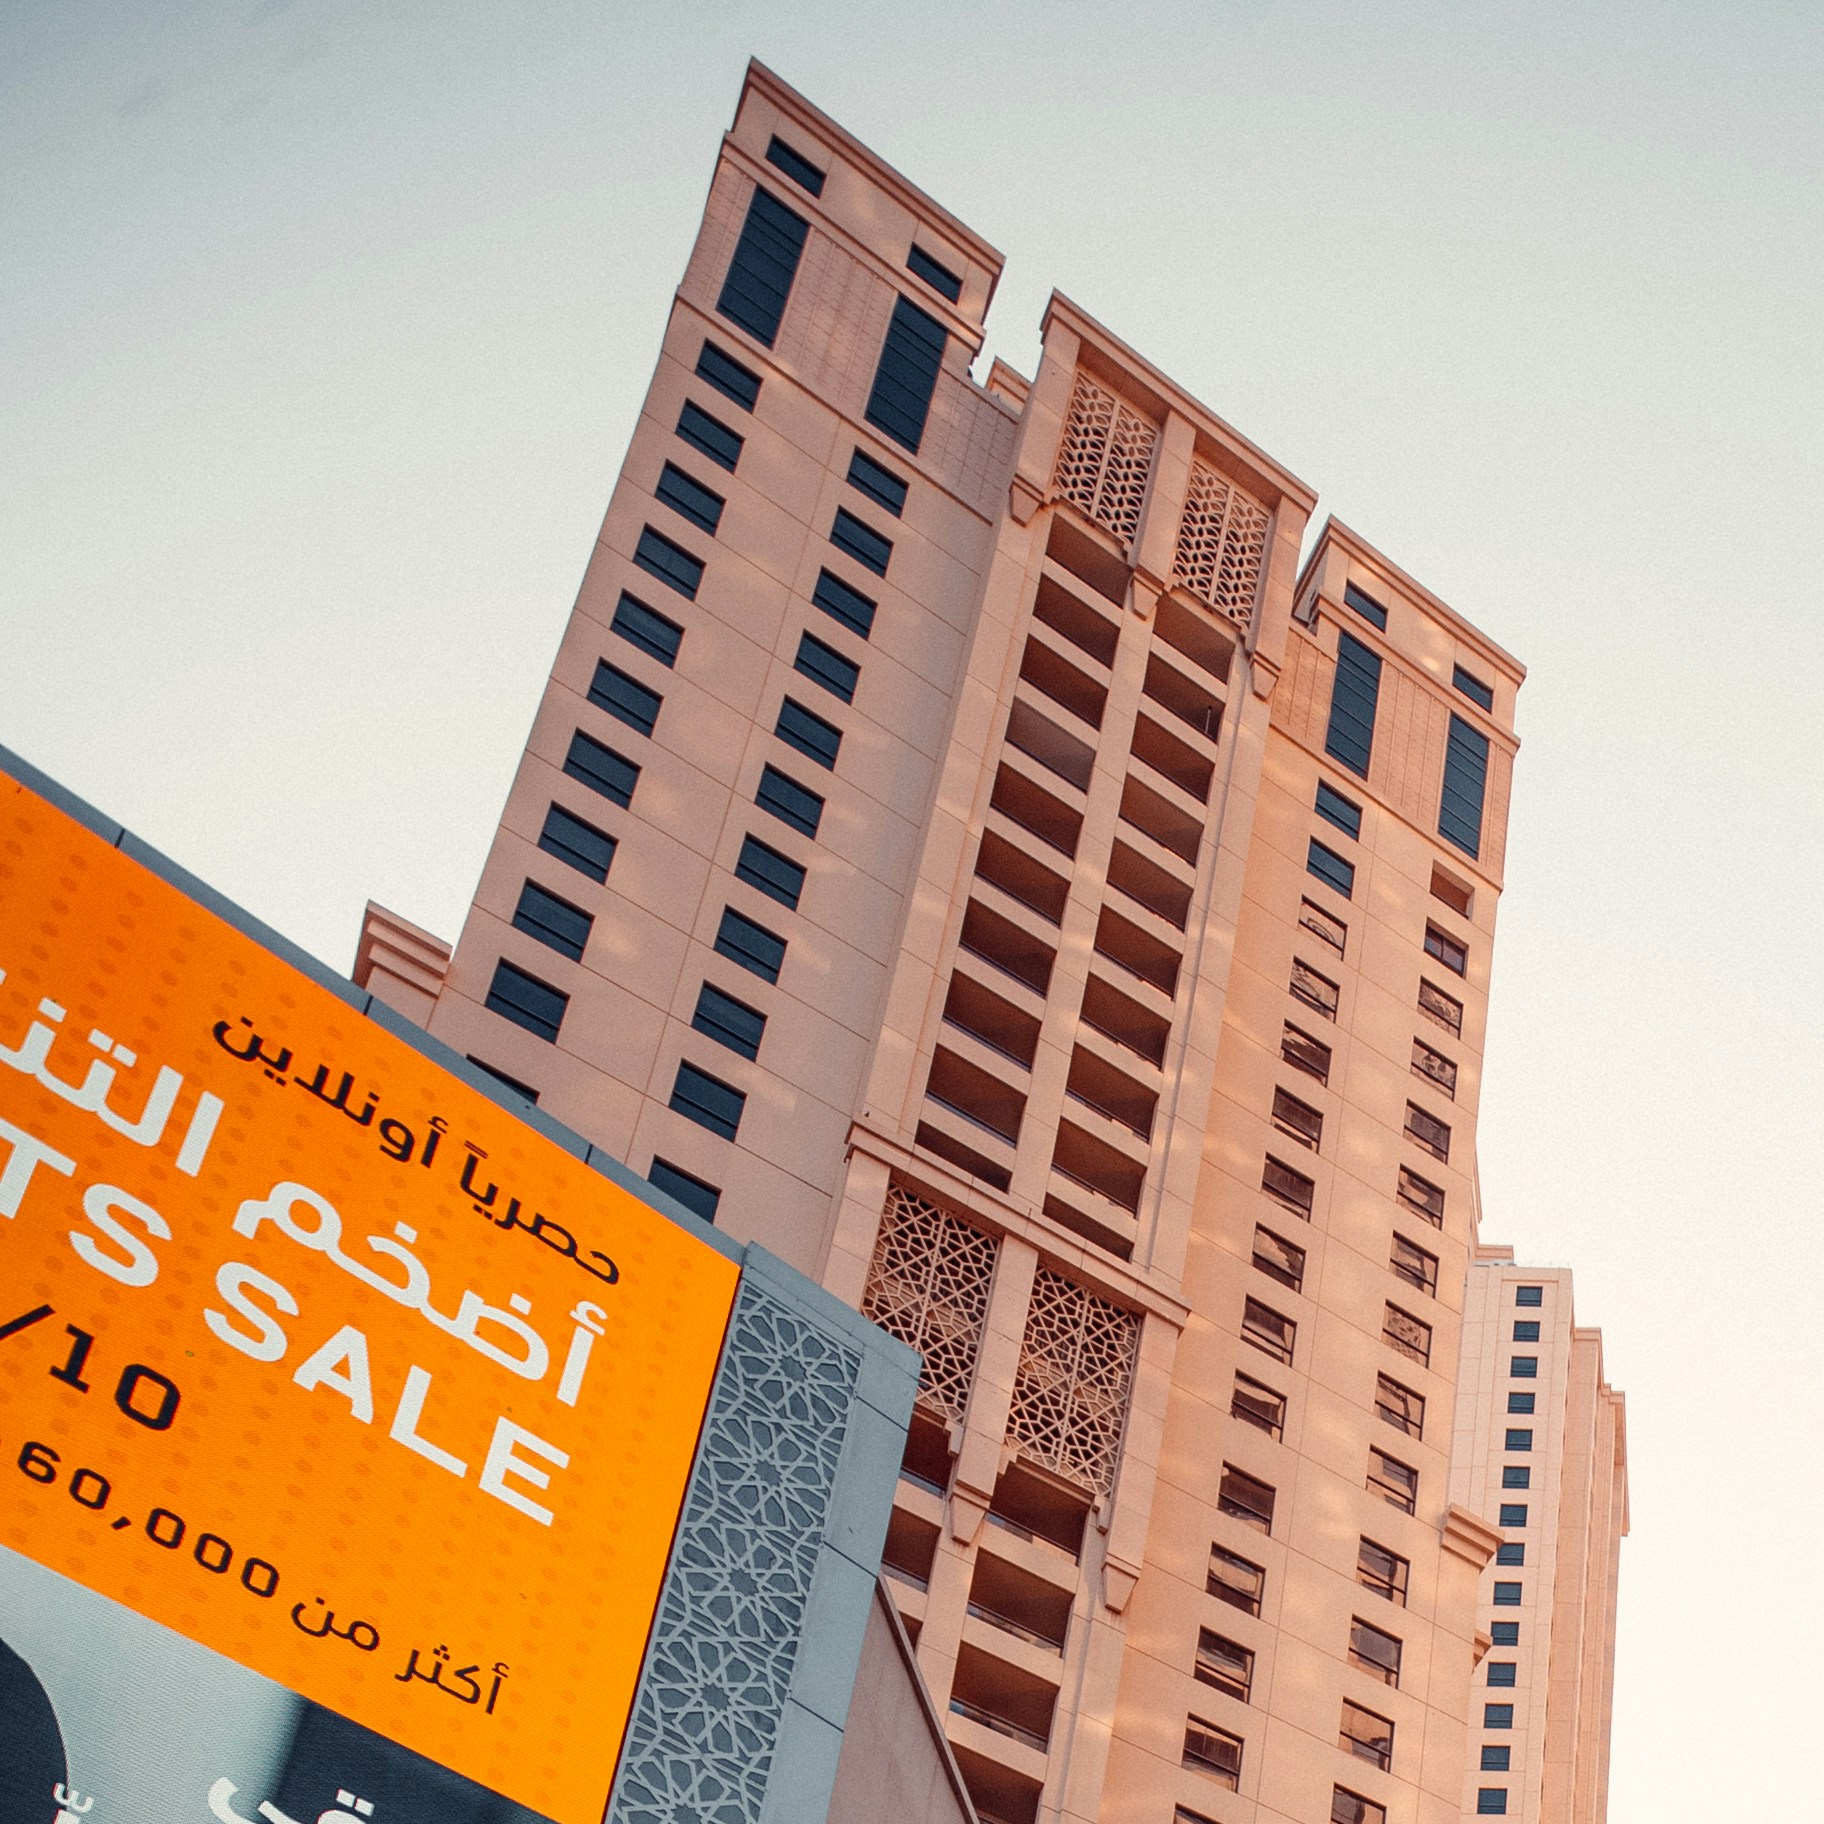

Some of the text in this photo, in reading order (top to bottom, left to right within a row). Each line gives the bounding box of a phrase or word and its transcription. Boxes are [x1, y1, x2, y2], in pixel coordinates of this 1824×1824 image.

[212, 1015, 449, 1168] أونلاين
[203, 1260, 571, 1527] SALE
[232, 1181, 608, 1408] أضخم
[17, 1440, 510, 1715] أكثر من 60,000
